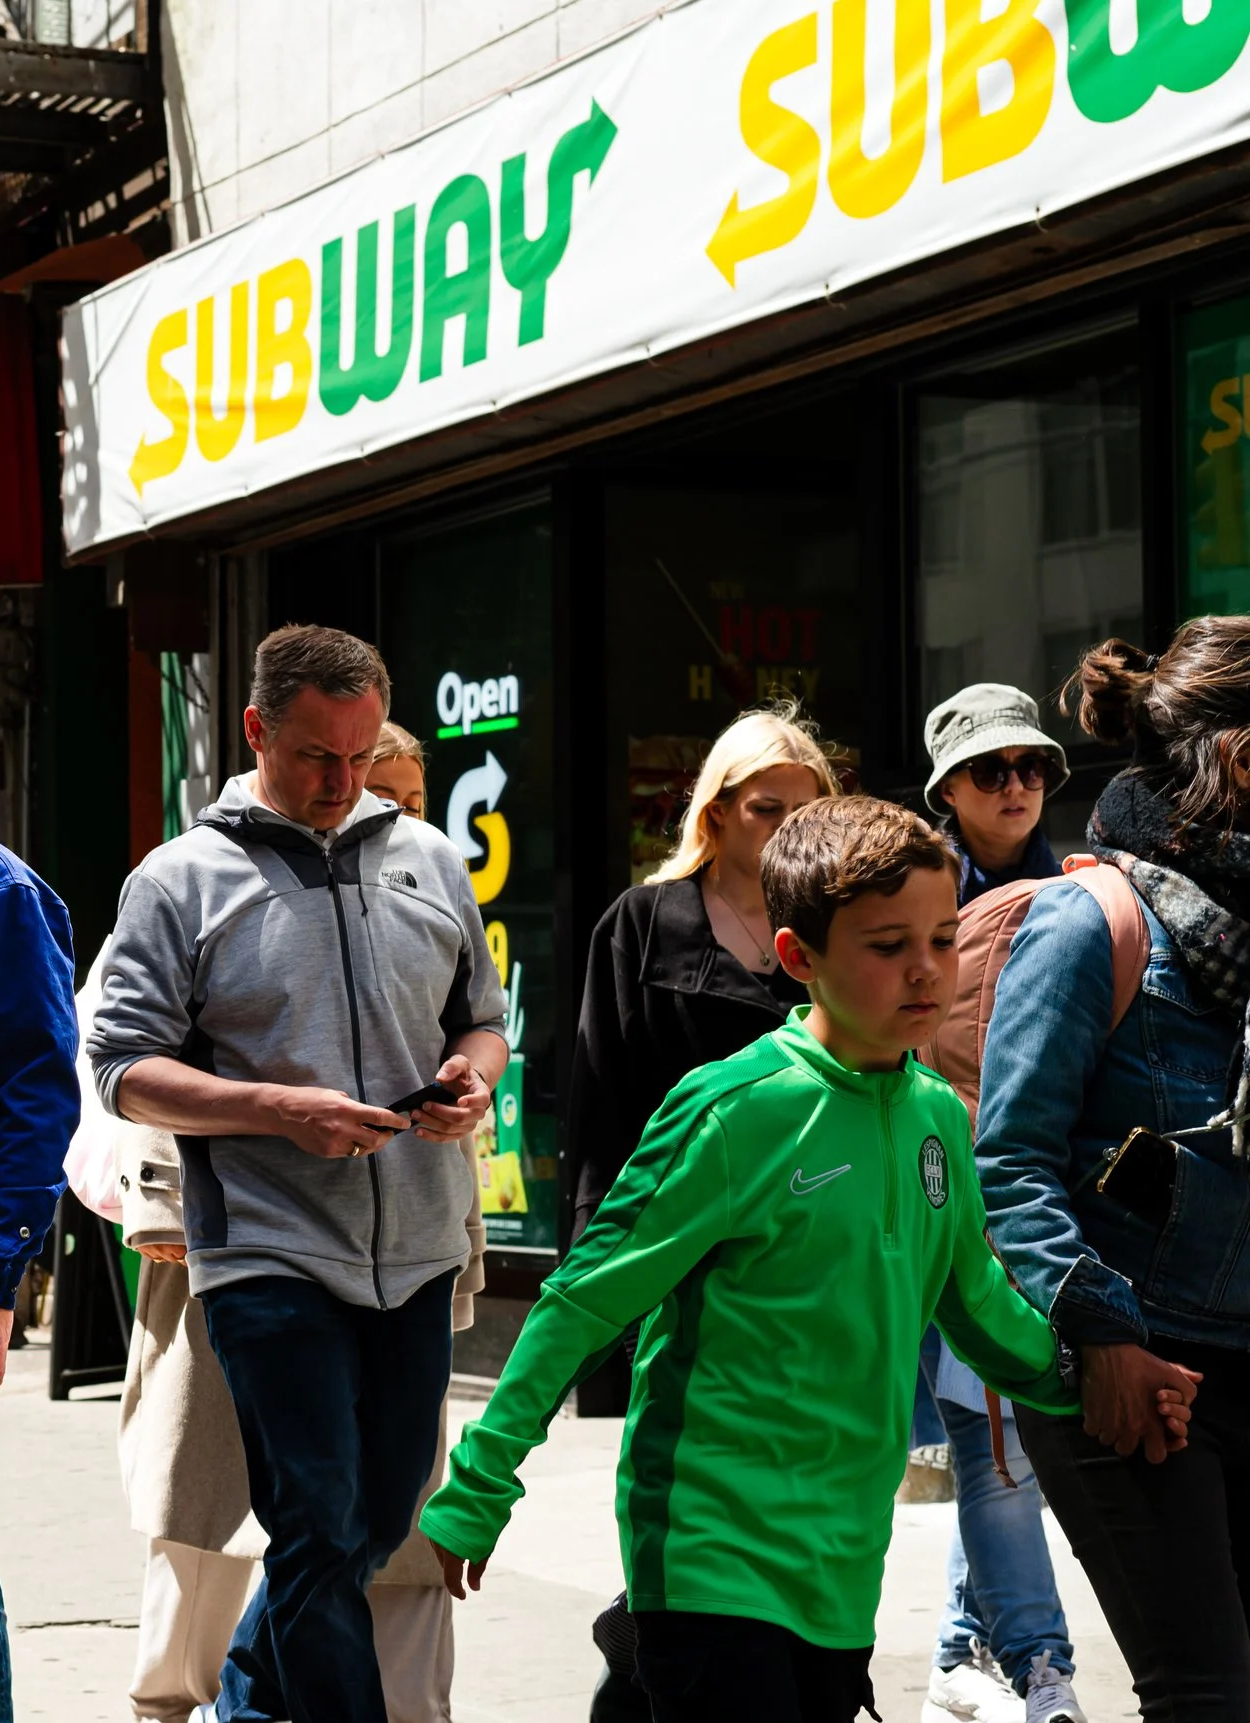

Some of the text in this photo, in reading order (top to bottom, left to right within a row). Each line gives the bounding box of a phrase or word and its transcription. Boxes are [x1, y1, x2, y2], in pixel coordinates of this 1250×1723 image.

[128, 97, 618, 496] SUBWAY
[1200, 373, 1250, 457] S
[719, 604, 825, 661] HOT
[437, 671, 519, 735] Open
[688, 664, 821, 704] HNEY
